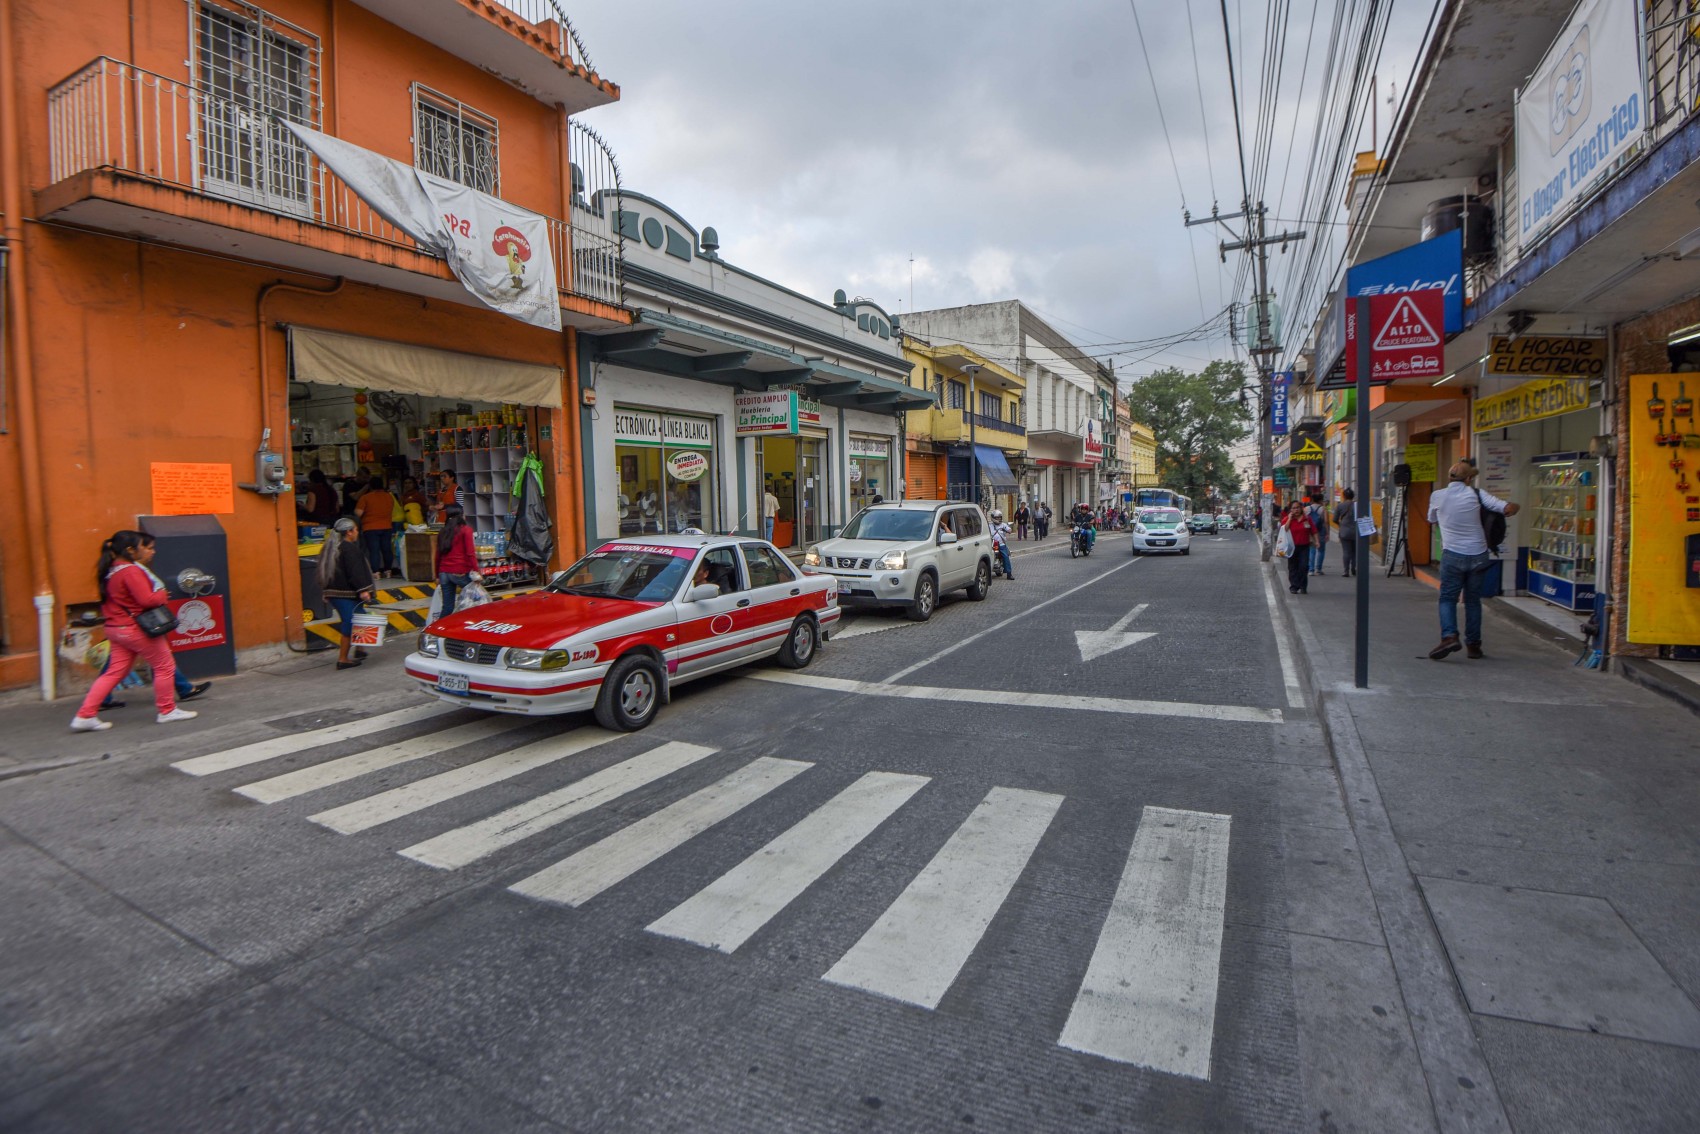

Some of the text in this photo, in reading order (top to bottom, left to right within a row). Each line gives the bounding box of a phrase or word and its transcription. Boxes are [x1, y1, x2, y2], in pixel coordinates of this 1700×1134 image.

[1533, 167, 1567, 224] Hogar
[1568, 92, 1639, 190] Eléctrico
[1348, 313, 1356, 340] Xalapa
[1390, 324, 1422, 337] ALTO
[1379, 335, 1434, 346] CRUCE PEATONAL
[1495, 339, 1593, 355] EL HOGAR
[1494, 357, 1603, 374] ELECTRICO
[763, 394, 788, 403] AMPLIO
[1274, 385, 1285, 425] HOTEL
[1524, 394, 1530, 417] A
[739, 415, 748, 425] La
[750, 412, 787, 424] Principal
[614, 413, 709, 440] ECTRÓNICA LÍNEA BLANCA
[304, 433, 312, 444] 3
[674, 454, 698, 465] ENTREGA
[1289, 453, 1324, 461] PIRMA
[676, 458, 704, 470] INMEDIATA
[641, 546, 674, 556] XALAPA
[171, 633, 224, 647] TOMA SIAMESA
